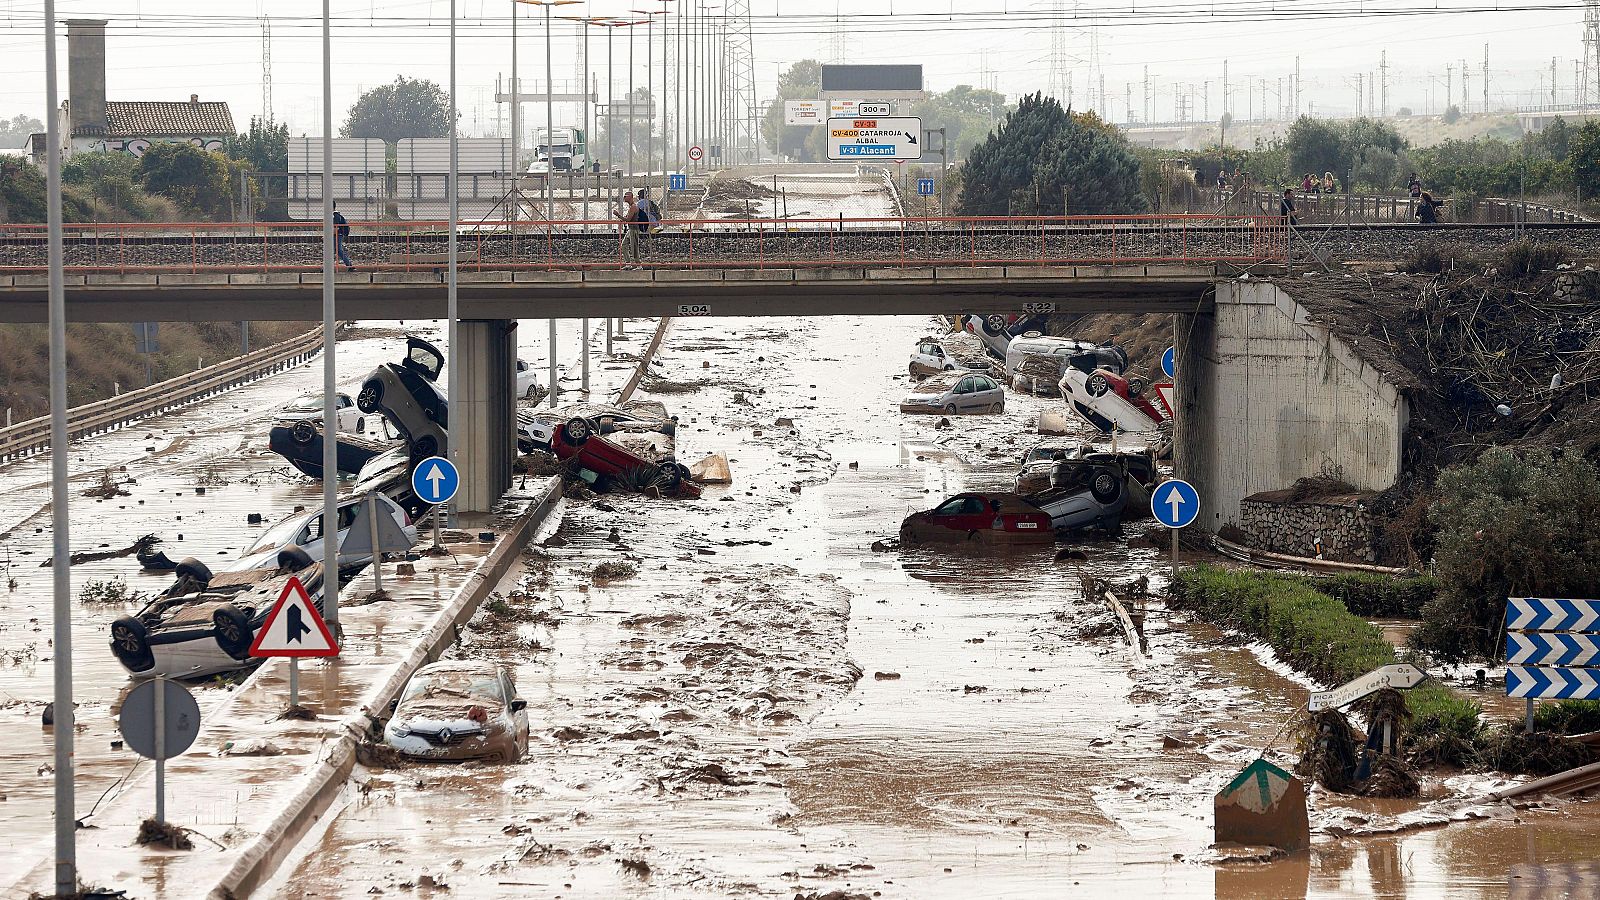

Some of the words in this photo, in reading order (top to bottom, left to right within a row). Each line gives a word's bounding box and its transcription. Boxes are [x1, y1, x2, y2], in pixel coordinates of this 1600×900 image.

[860, 146, 895, 155] Alacant
[1313, 688, 1349, 700] PICANYA
[1313, 689, 1361, 708] TORRENT
